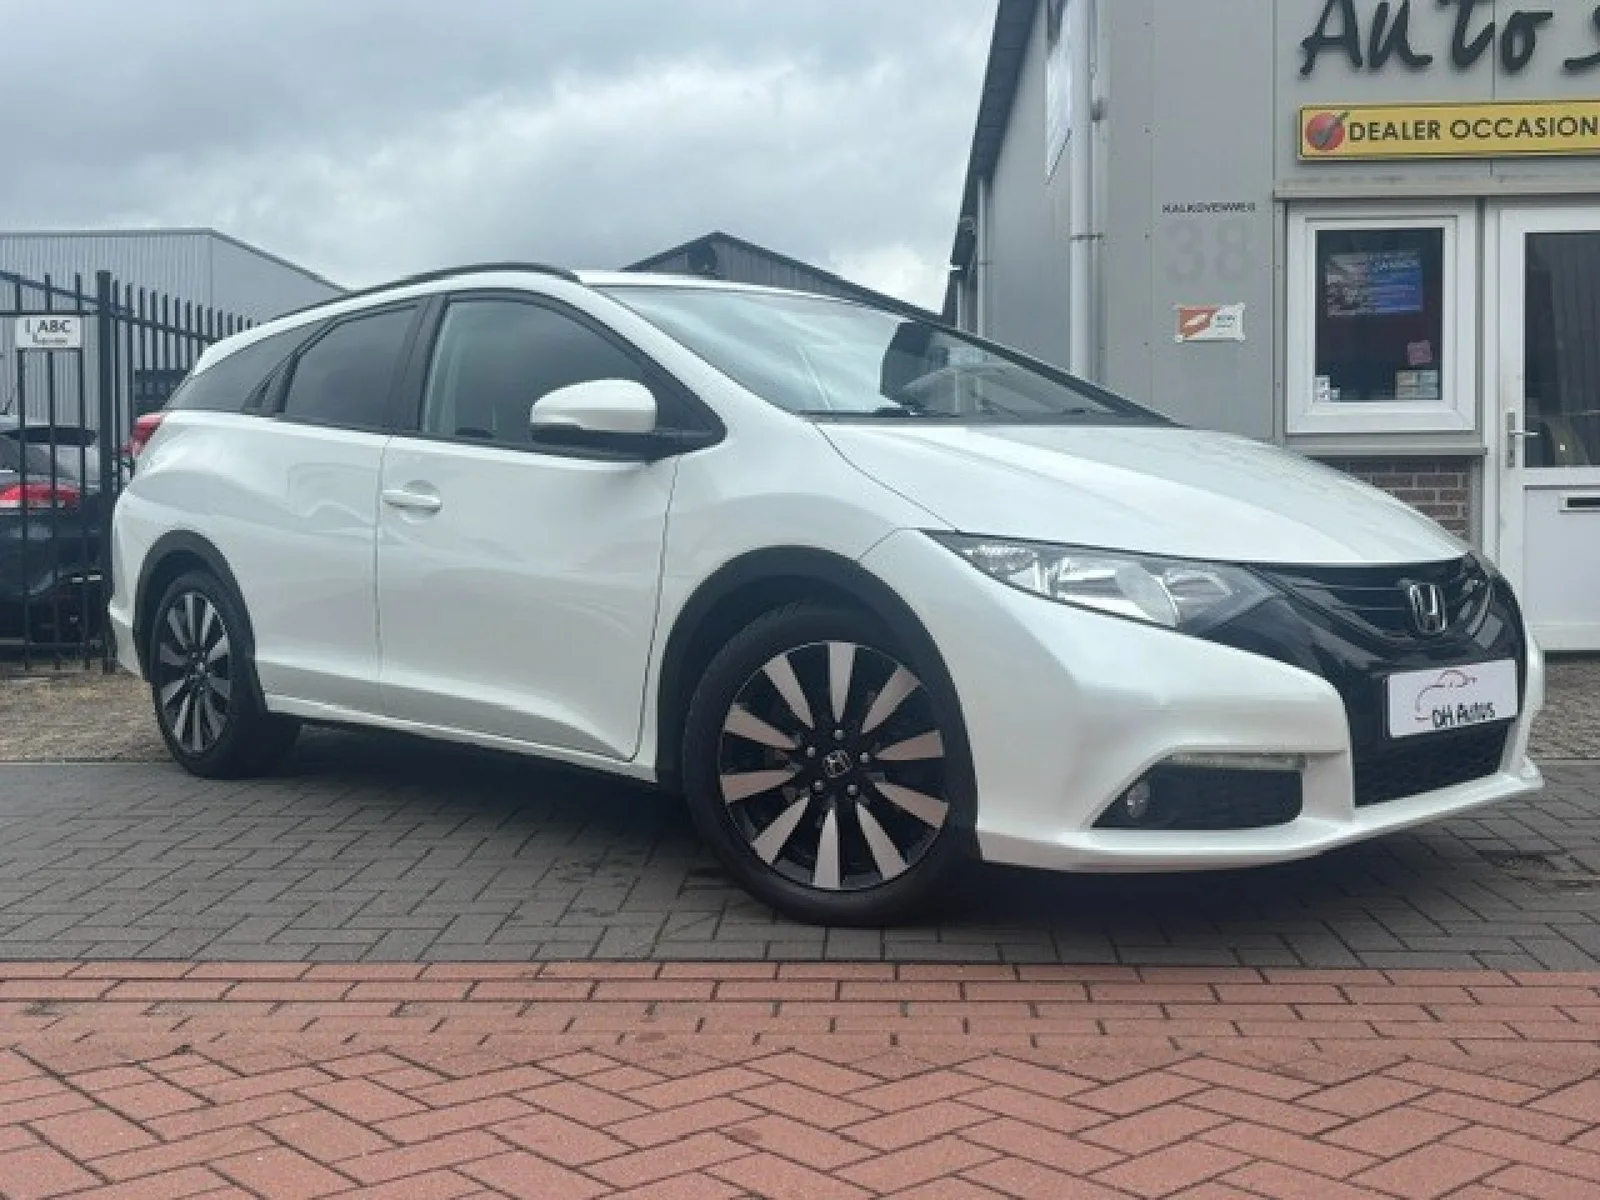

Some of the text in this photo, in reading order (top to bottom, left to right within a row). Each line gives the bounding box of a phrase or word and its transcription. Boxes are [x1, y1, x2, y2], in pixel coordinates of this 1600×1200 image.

[1300, 0, 1553, 76] Auto
[1349, 116, 1598, 141] DEALER OCCASION
